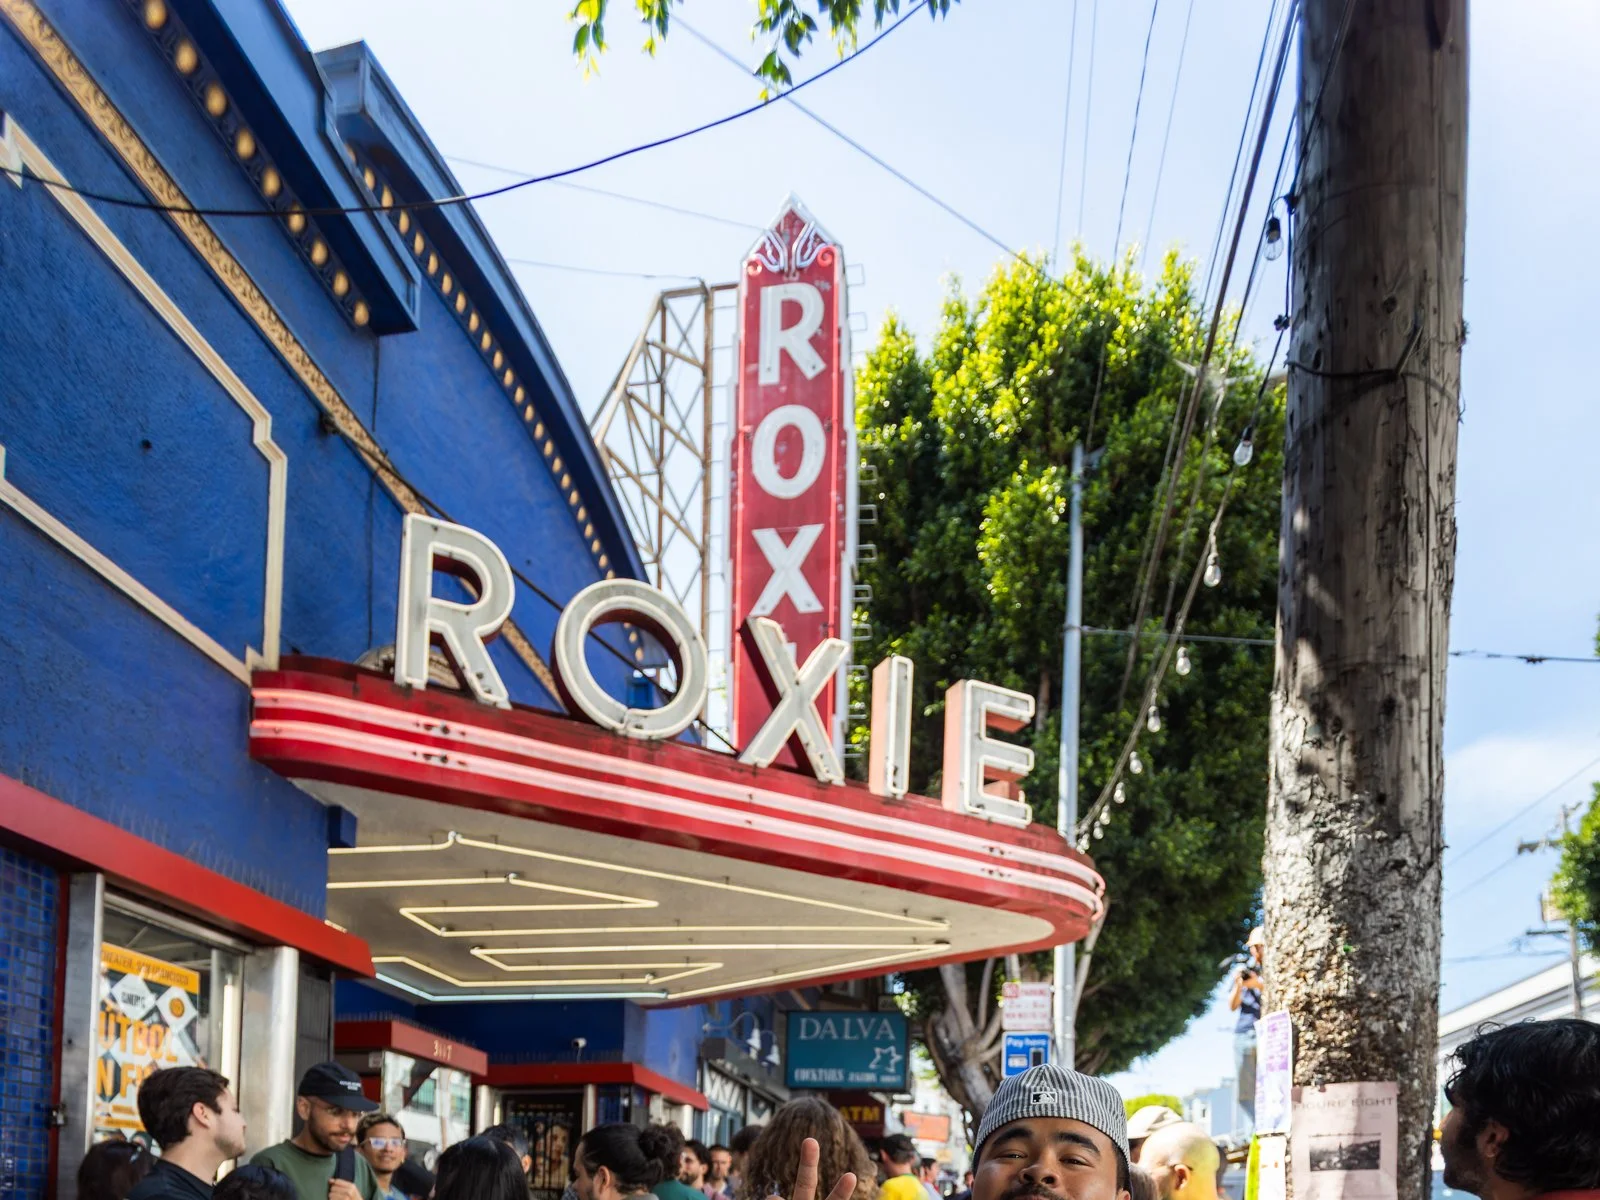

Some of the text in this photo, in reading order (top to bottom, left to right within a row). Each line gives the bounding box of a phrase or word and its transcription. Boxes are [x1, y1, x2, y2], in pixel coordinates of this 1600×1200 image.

[749, 281, 828, 668] ROX
[394, 512, 1037, 828] ROXIE
[799, 1017, 896, 1040] DALVA
[1007, 1036, 1023, 1048] Pay
[838, 1105, 880, 1122] ATM
[1293, 1096, 1394, 1111] FIGURE EIGHT
